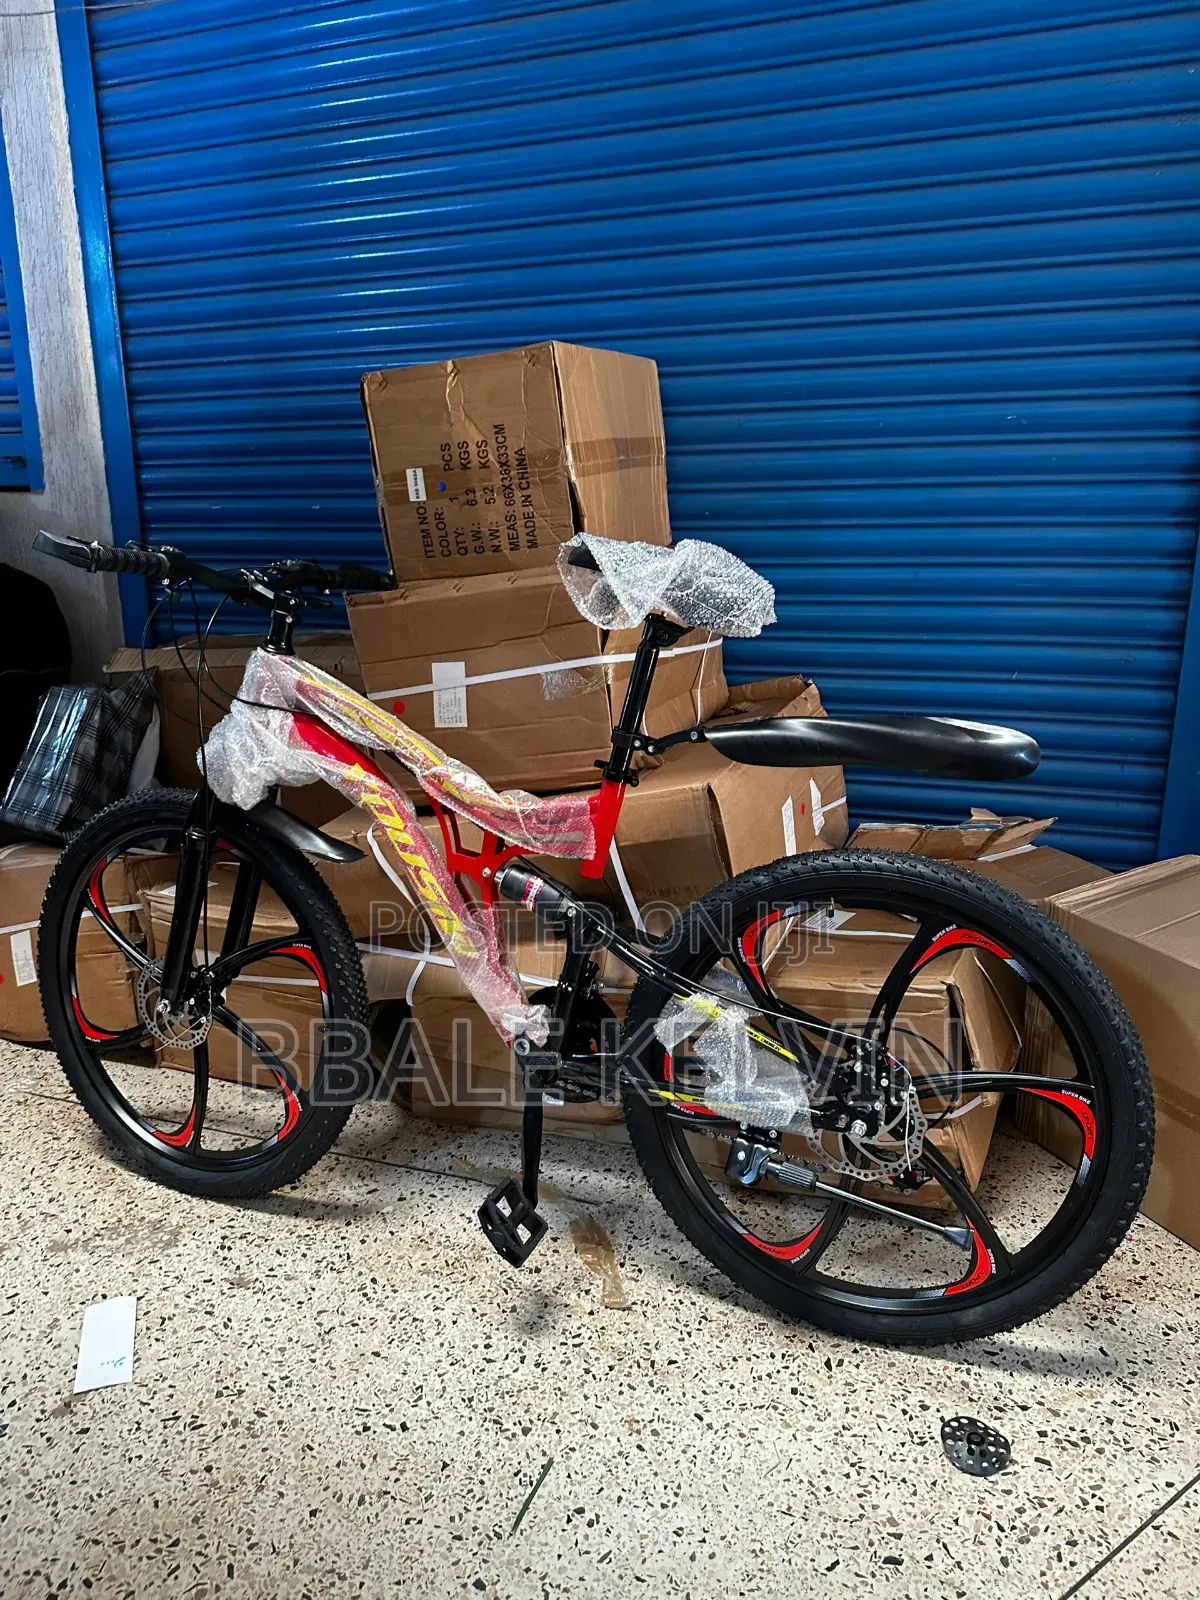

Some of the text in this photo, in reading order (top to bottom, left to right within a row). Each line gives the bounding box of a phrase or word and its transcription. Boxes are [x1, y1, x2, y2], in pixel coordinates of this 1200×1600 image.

[441, 443, 454, 471] PCS
[458, 441, 485, 554] G.W.: 6.2 KGS
[476, 440, 502, 553] N.W.: 5.2 KGS
[514, 447, 538, 549] MADE IN CHINA
[415, 501, 436, 558] ITEM NO:
[434, 507, 451, 557] COLOR:
[454, 527, 468, 556] QTY:
[505, 510, 520, 551] MEAS:
[931, 923, 958, 942] SUPER BIKE
[1061, 1089, 1091, 1105] SUPER BIKE
[1082, 1109, 1093, 1141] SPORT
